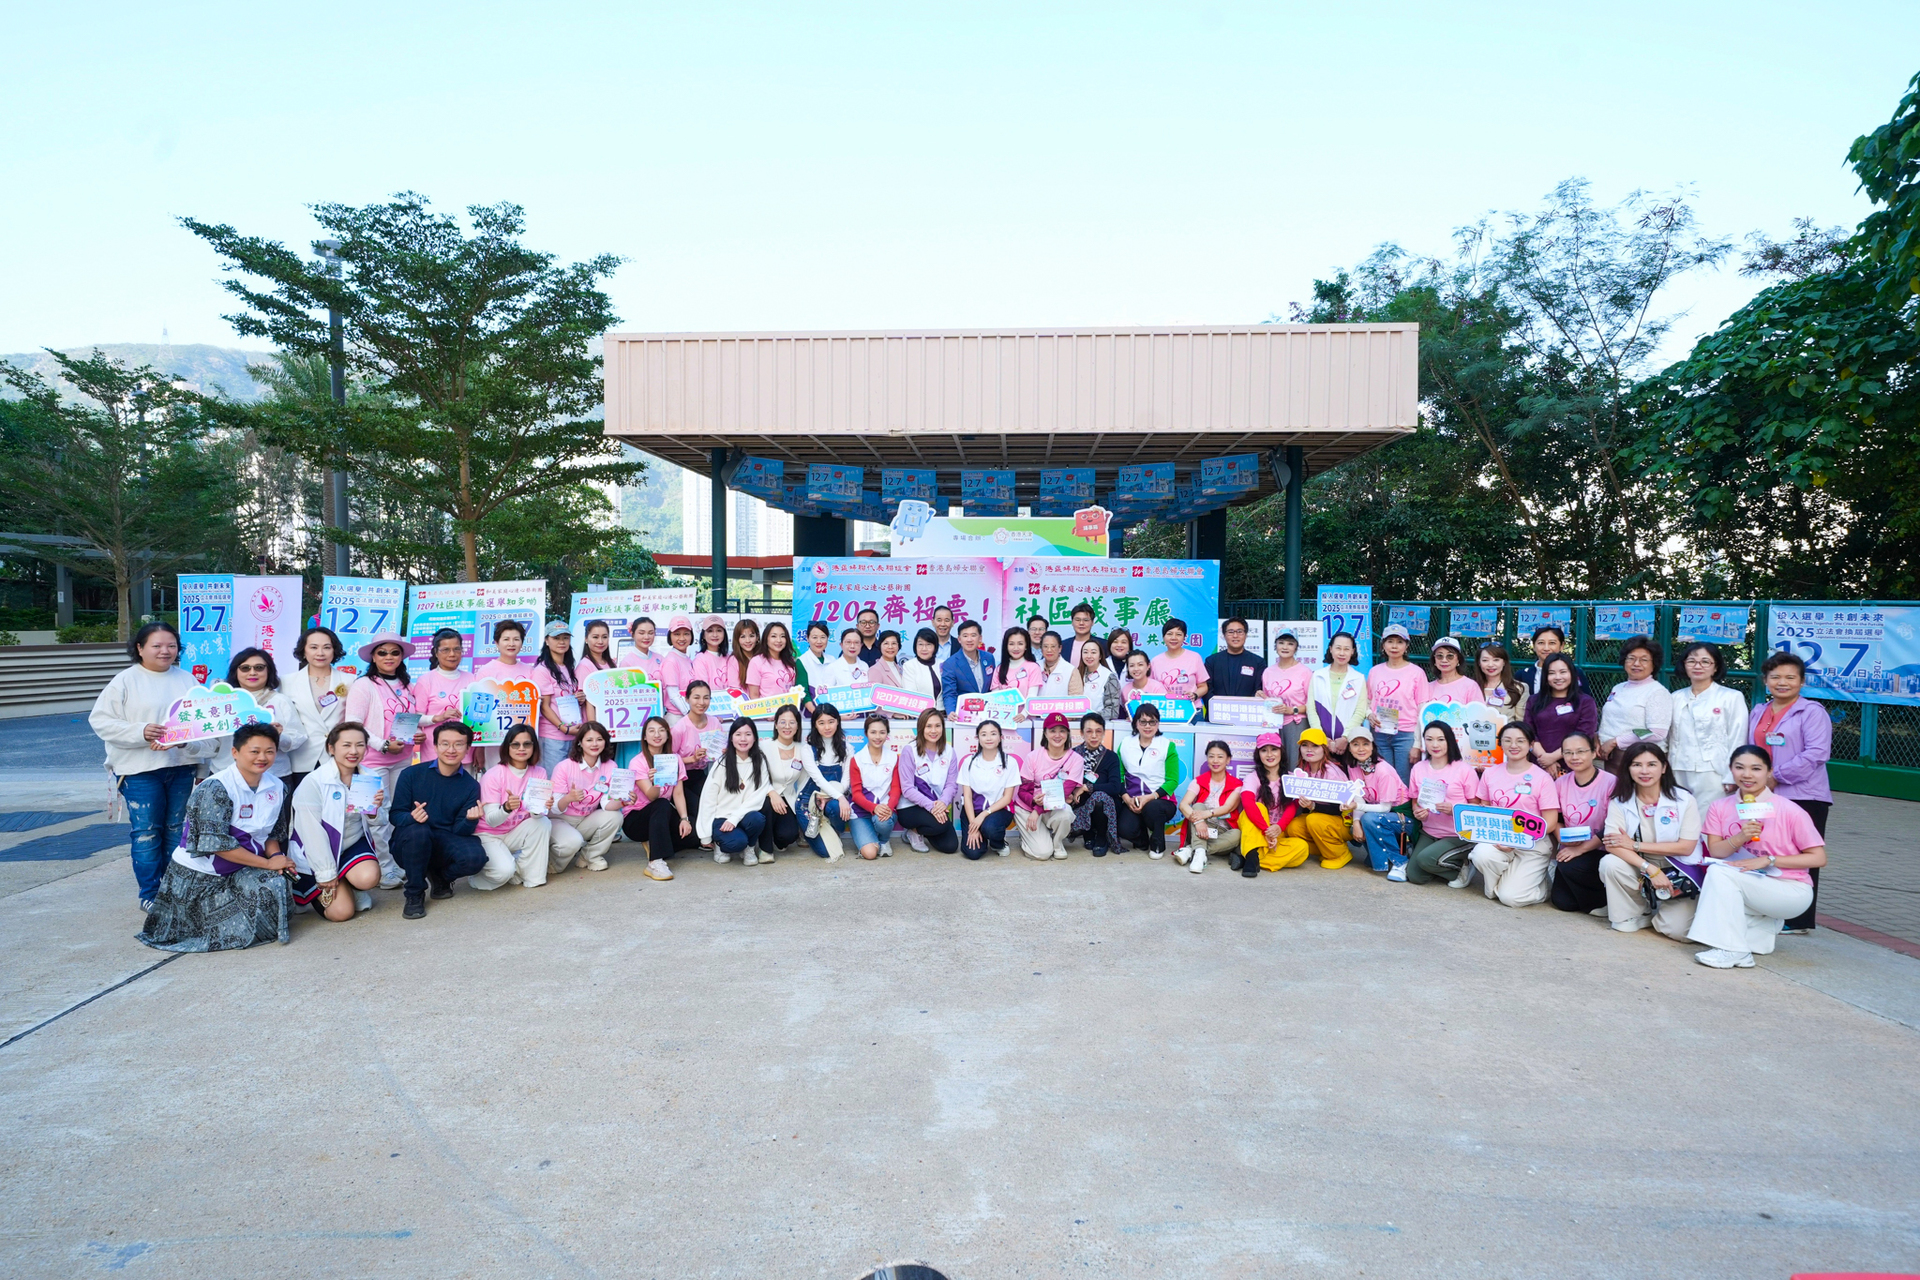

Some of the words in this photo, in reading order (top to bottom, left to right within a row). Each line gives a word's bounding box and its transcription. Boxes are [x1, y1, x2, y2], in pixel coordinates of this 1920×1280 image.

[929, 564, 986, 572] 香港島婦女聯會
[1146, 566, 1204, 575] 香港島婦女聯會
[329, 584, 362, 592] 投入選舉
[367, 586, 399, 594] 共創未來
[829, 583, 911, 592] 和美家庭心連心藝術團
[1042, 585, 1127, 594] 和美家庭心連心藝術團
[328, 596, 355, 605] 2025
[1015, 595, 1175, 628] 社區議事廳
[1322, 604, 1341, 612] 2025
[1777, 611, 1825, 621] 投入選舉
[1834, 613, 1884, 622] 共創未來
[1776, 626, 1815, 638] 2025
[1816, 627, 1883, 637] 立法會換屆選舉
[178, 703, 237, 723] 發表意見
[202, 714, 260, 734] 共創未來
[1286, 777, 1347, 793] 共創明天齊出力
[1290, 787, 1339, 799] 1207約定你
[1463, 814, 1515, 831] 選賢與能
[1514, 815, 1543, 834] GO!
[1475, 828, 1527, 845] 共創未來
